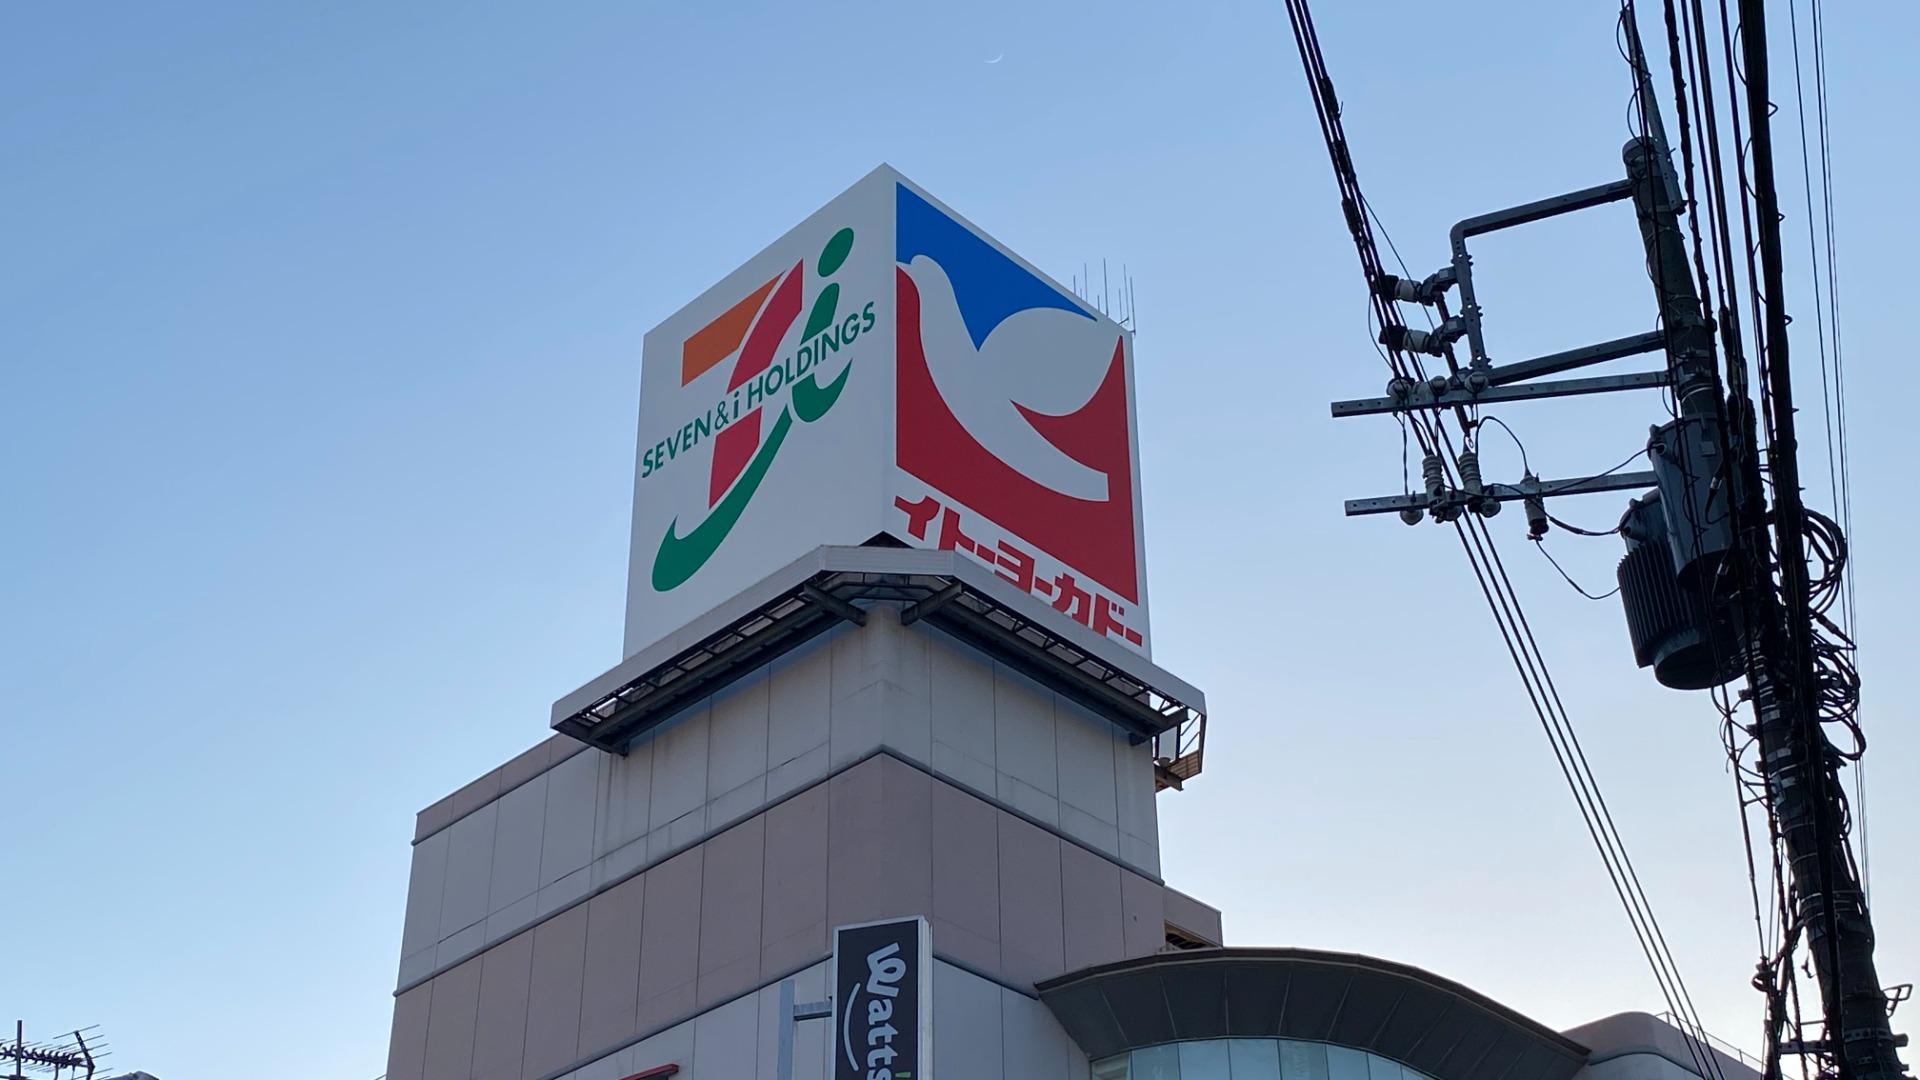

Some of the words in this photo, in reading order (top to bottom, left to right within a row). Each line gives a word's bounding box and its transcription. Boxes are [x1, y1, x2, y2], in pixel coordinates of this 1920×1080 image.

[747, 301, 876, 410] HOLDINGS
[894, 495, 1143, 647] イトーヨーカドー
